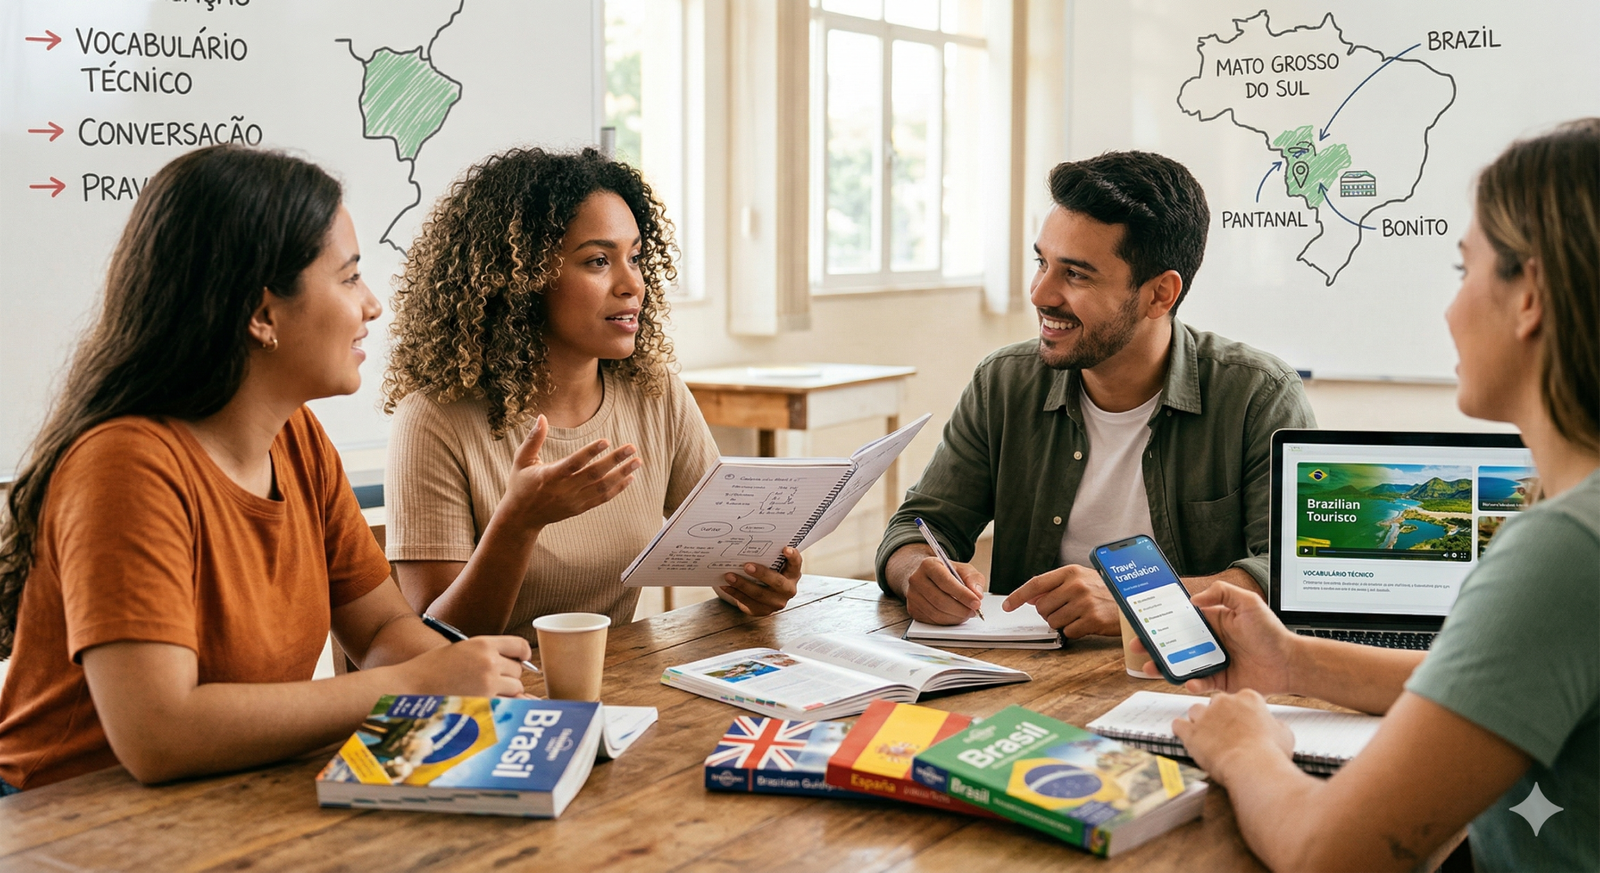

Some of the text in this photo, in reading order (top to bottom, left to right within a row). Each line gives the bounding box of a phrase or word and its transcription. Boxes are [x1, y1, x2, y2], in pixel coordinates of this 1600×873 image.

[75, 26, 248, 61] VOCABULÁRIO
[1428, 26, 1501, 50] BRAZIL
[1216, 53, 1340, 77] MATO GROSSO
[80, 61, 193, 95] TÉCNICO
[1245, 79, 1310, 99] DO SUL
[1222, 211, 1308, 229] PANTANAL
[1382, 215, 1448, 237] BONITO
[1307, 498, 1361, 510] Brazilian
[1306, 511, 1357, 523] Tourisco
[1110, 560, 1137, 574] Travel
[1115, 565, 1160, 583] translation
[1303, 569, 1375, 578] VOCABULÁRIO TÉCNICO
[491, 709, 563, 778] Brasil
[957, 721, 1050, 769] Brasil
[950, 776, 990, 805] Brasil
